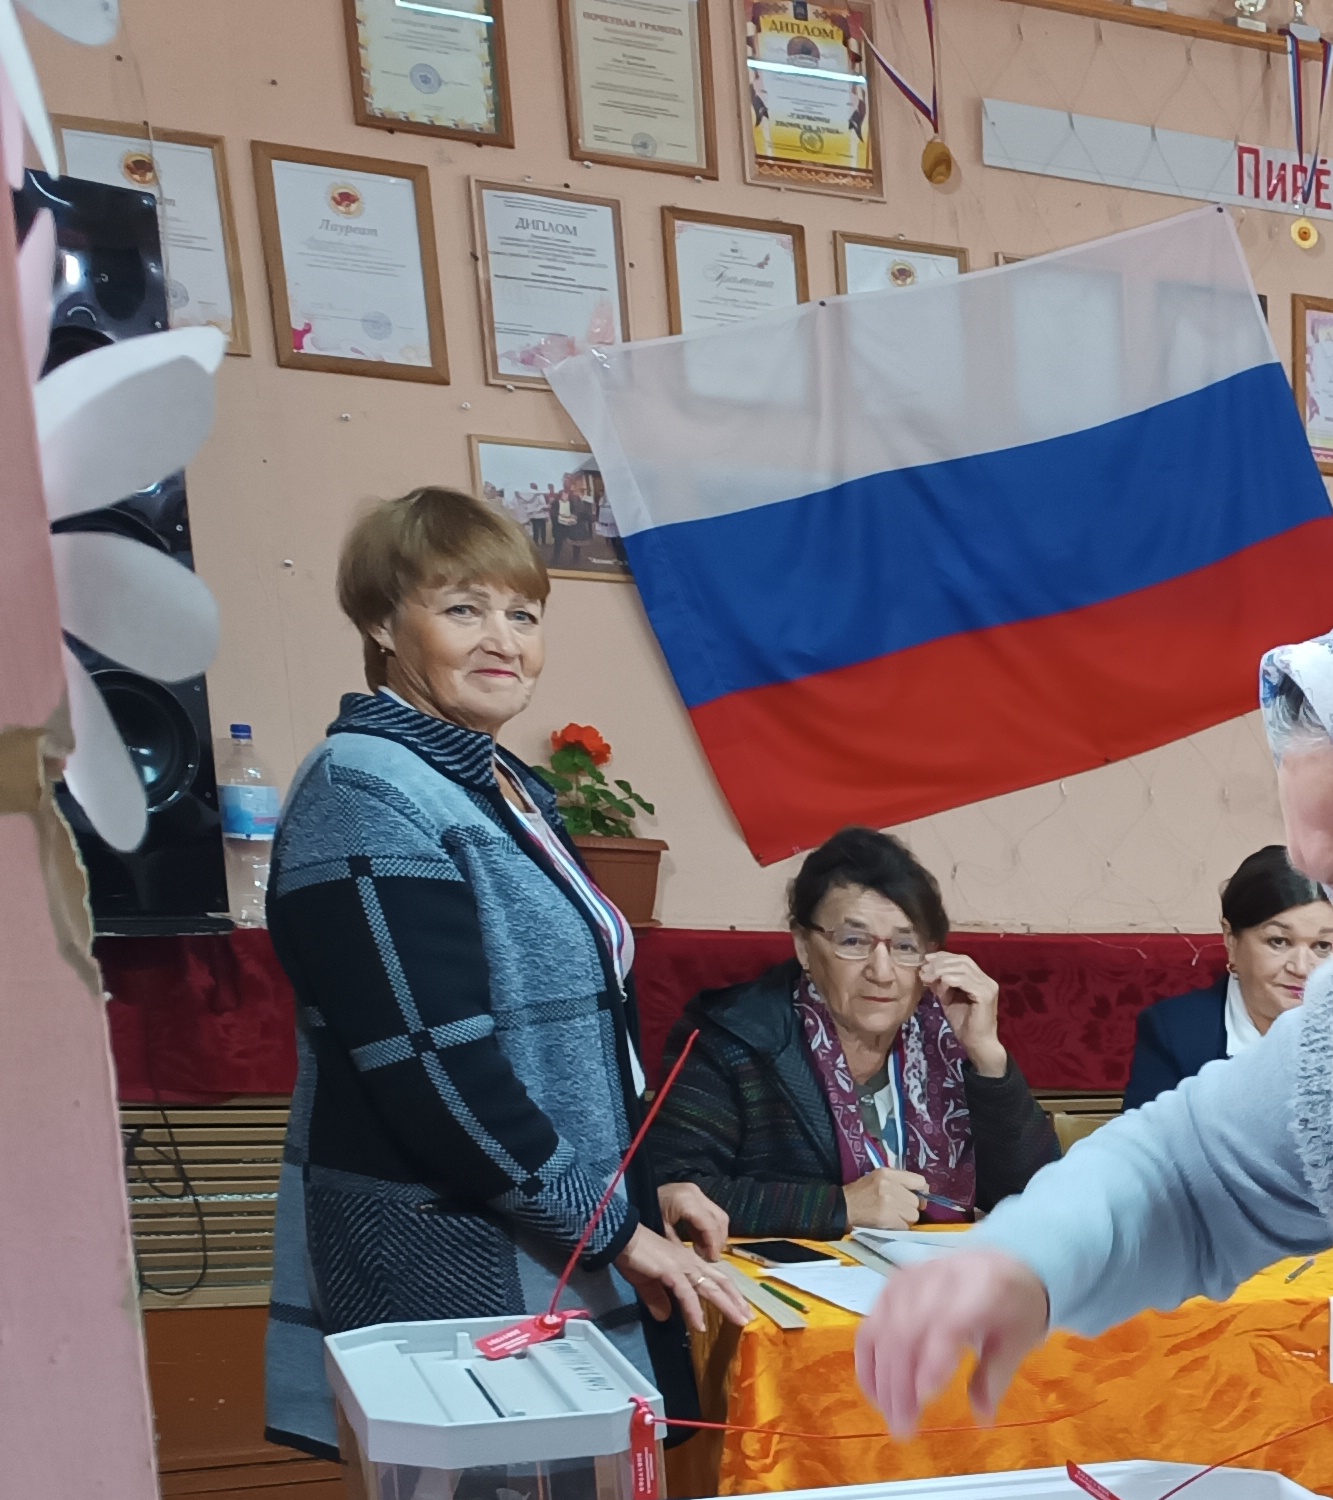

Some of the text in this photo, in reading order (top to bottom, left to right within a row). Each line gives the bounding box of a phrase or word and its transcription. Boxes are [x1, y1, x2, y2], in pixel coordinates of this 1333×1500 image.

[769, 19, 835, 40] ДИПЛОМ
[318, 218, 378, 237] Лауреат
[514, 216, 578, 237] ДИПЛОМ
